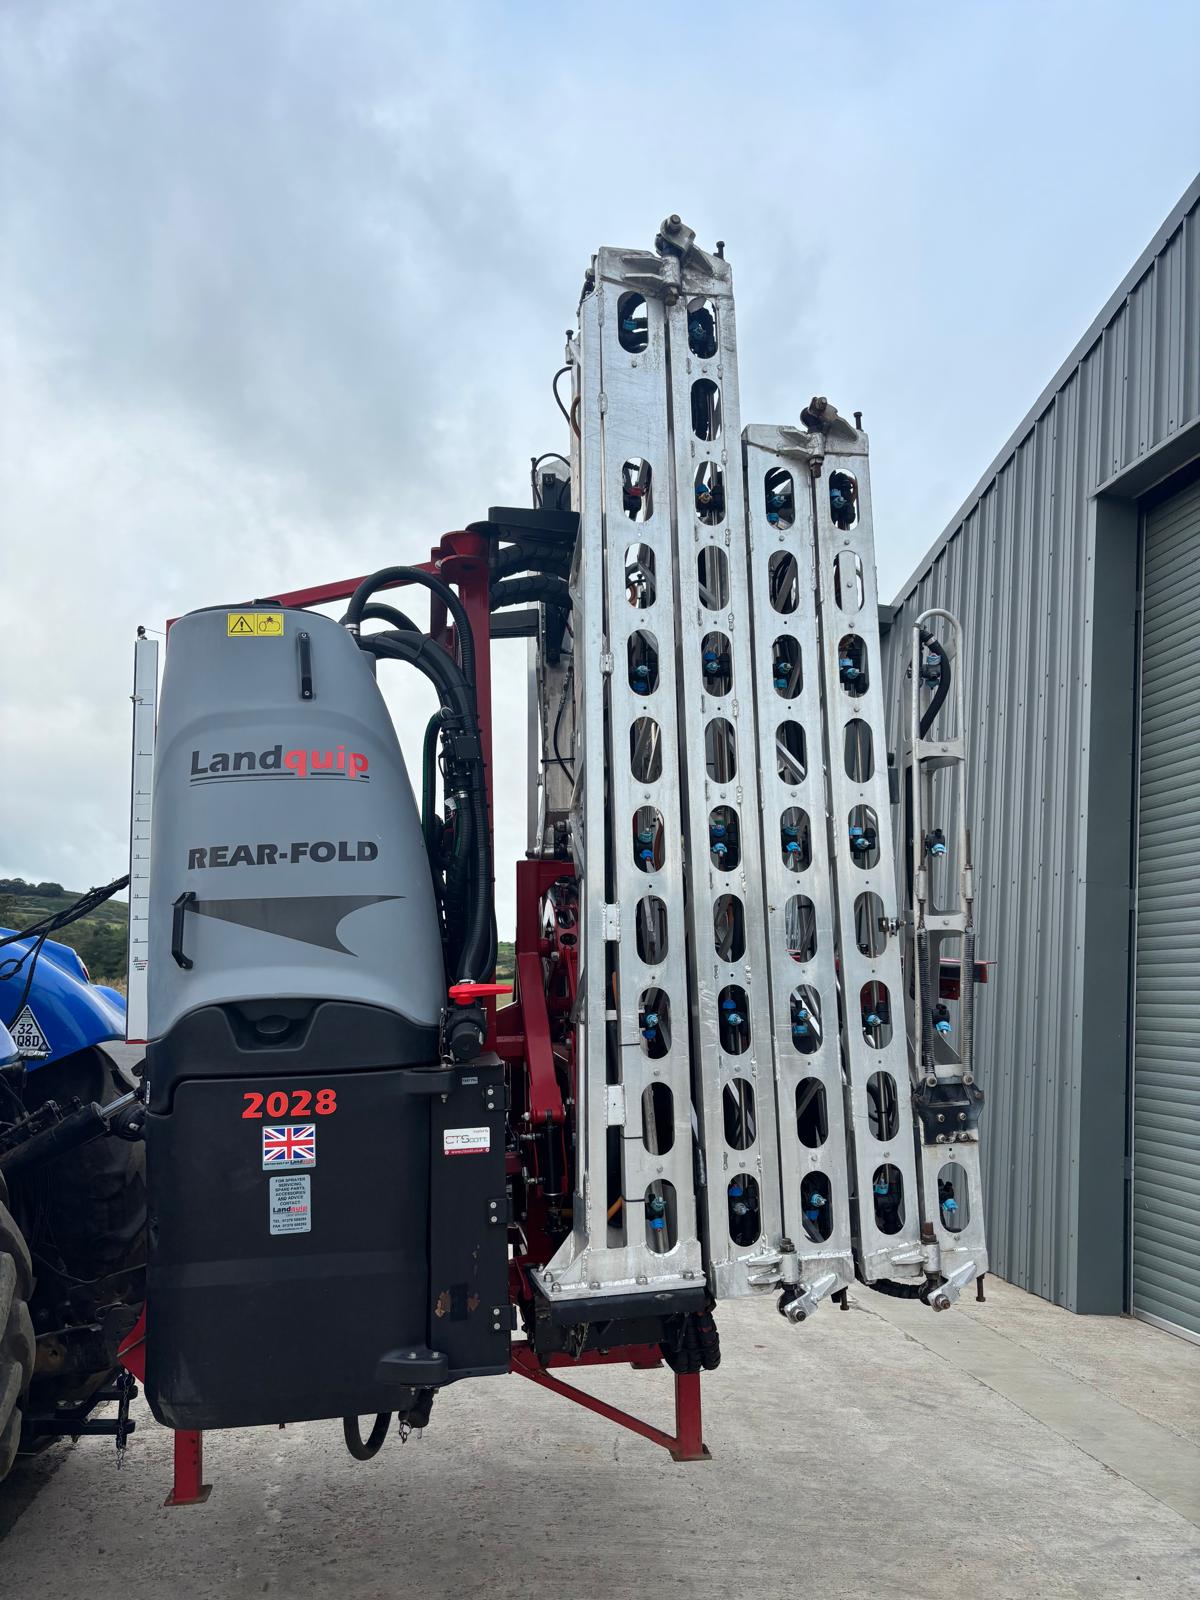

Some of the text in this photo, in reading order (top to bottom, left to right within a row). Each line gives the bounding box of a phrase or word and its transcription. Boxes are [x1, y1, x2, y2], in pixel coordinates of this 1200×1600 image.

[190, 745, 369, 778] Landquip
[188, 841, 379, 870] REAR-FOLD
[17, 1023, 33, 1034] 32
[241, 1088, 337, 1119] 2028
